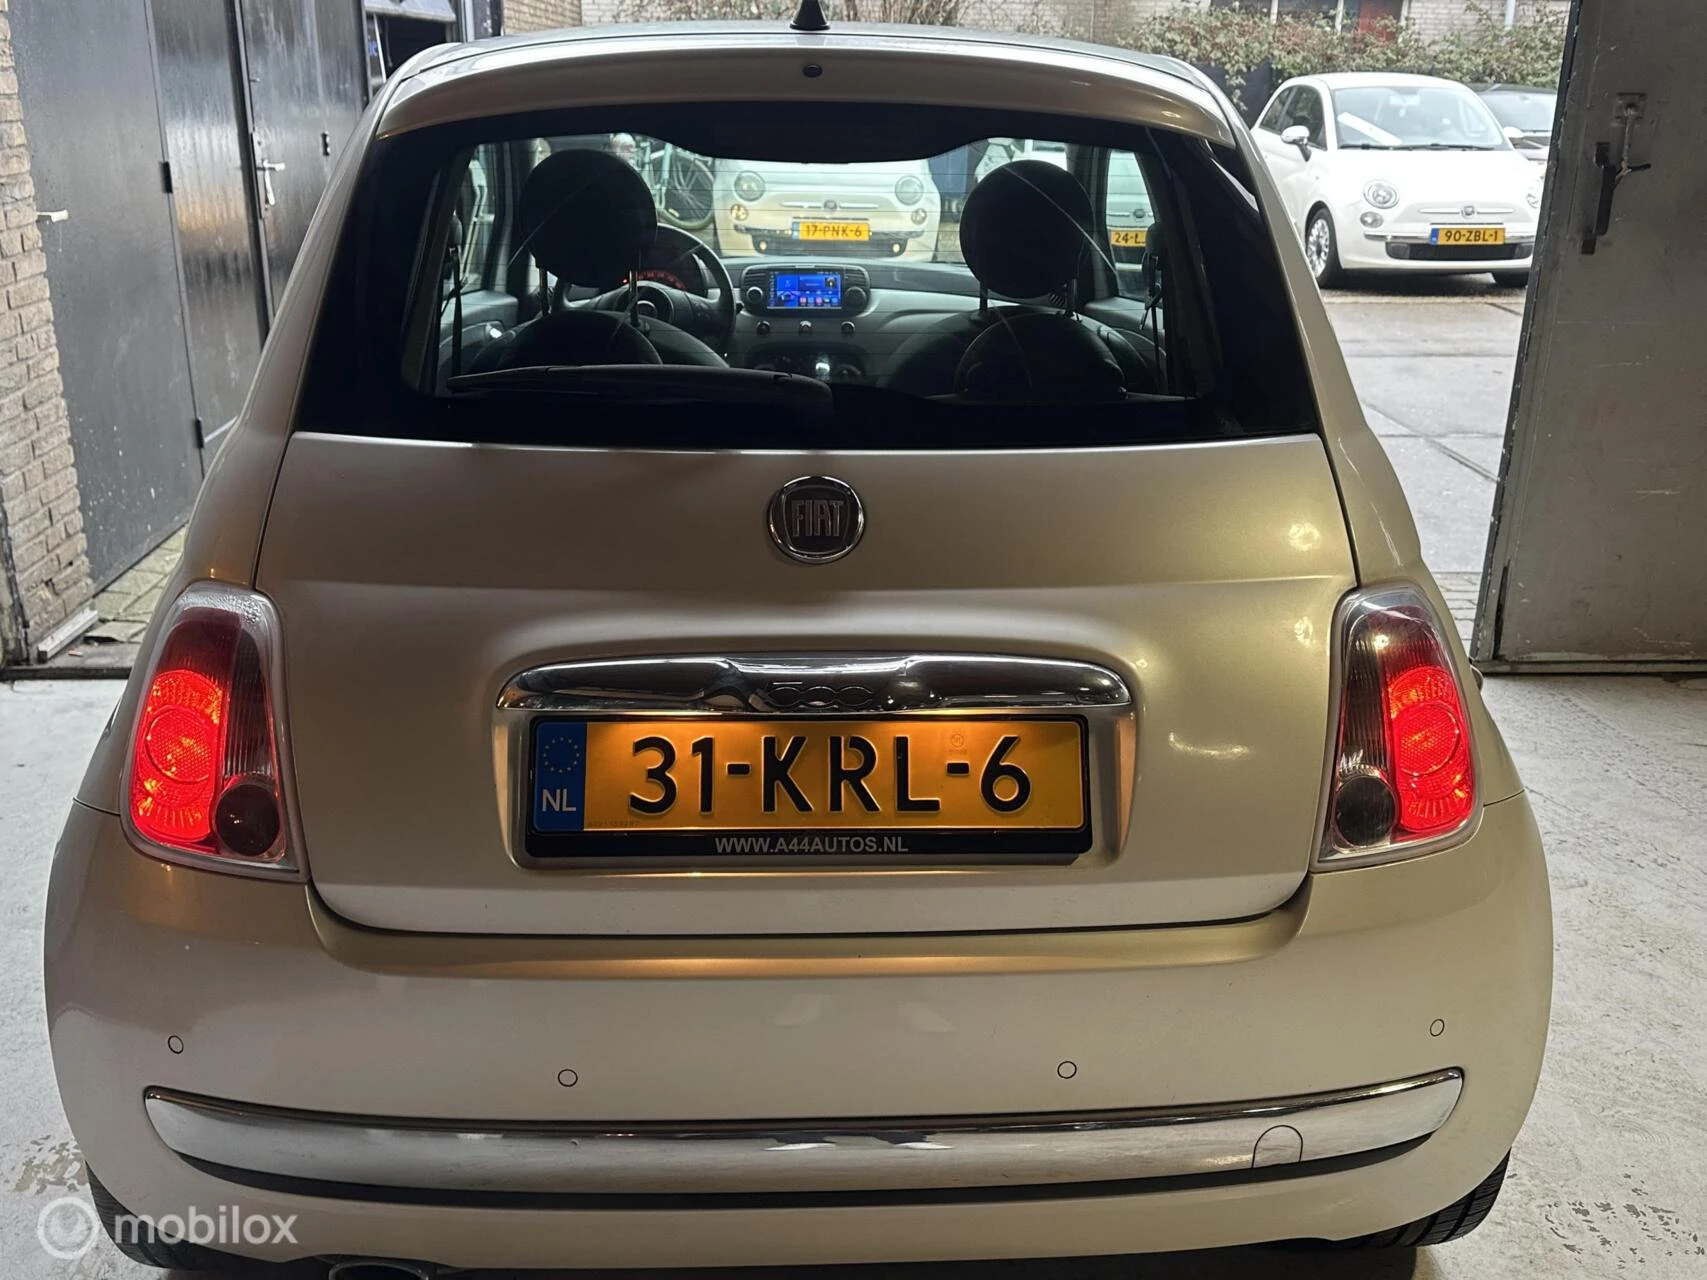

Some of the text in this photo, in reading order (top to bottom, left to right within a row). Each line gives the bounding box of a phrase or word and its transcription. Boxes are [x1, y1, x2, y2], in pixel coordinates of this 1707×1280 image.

[806, 224, 862, 237] 17-PNK-6
[1114, 232, 1146, 244] 24-L
[1444, 230, 1498, 242] 90-ZBL-1
[791, 499, 844, 537] FIAT
[628, 735, 1031, 815] 31-KRL-6
[541, 788, 577, 812] NL
[715, 836, 909, 853] WWW.A44AUTOS.NL
